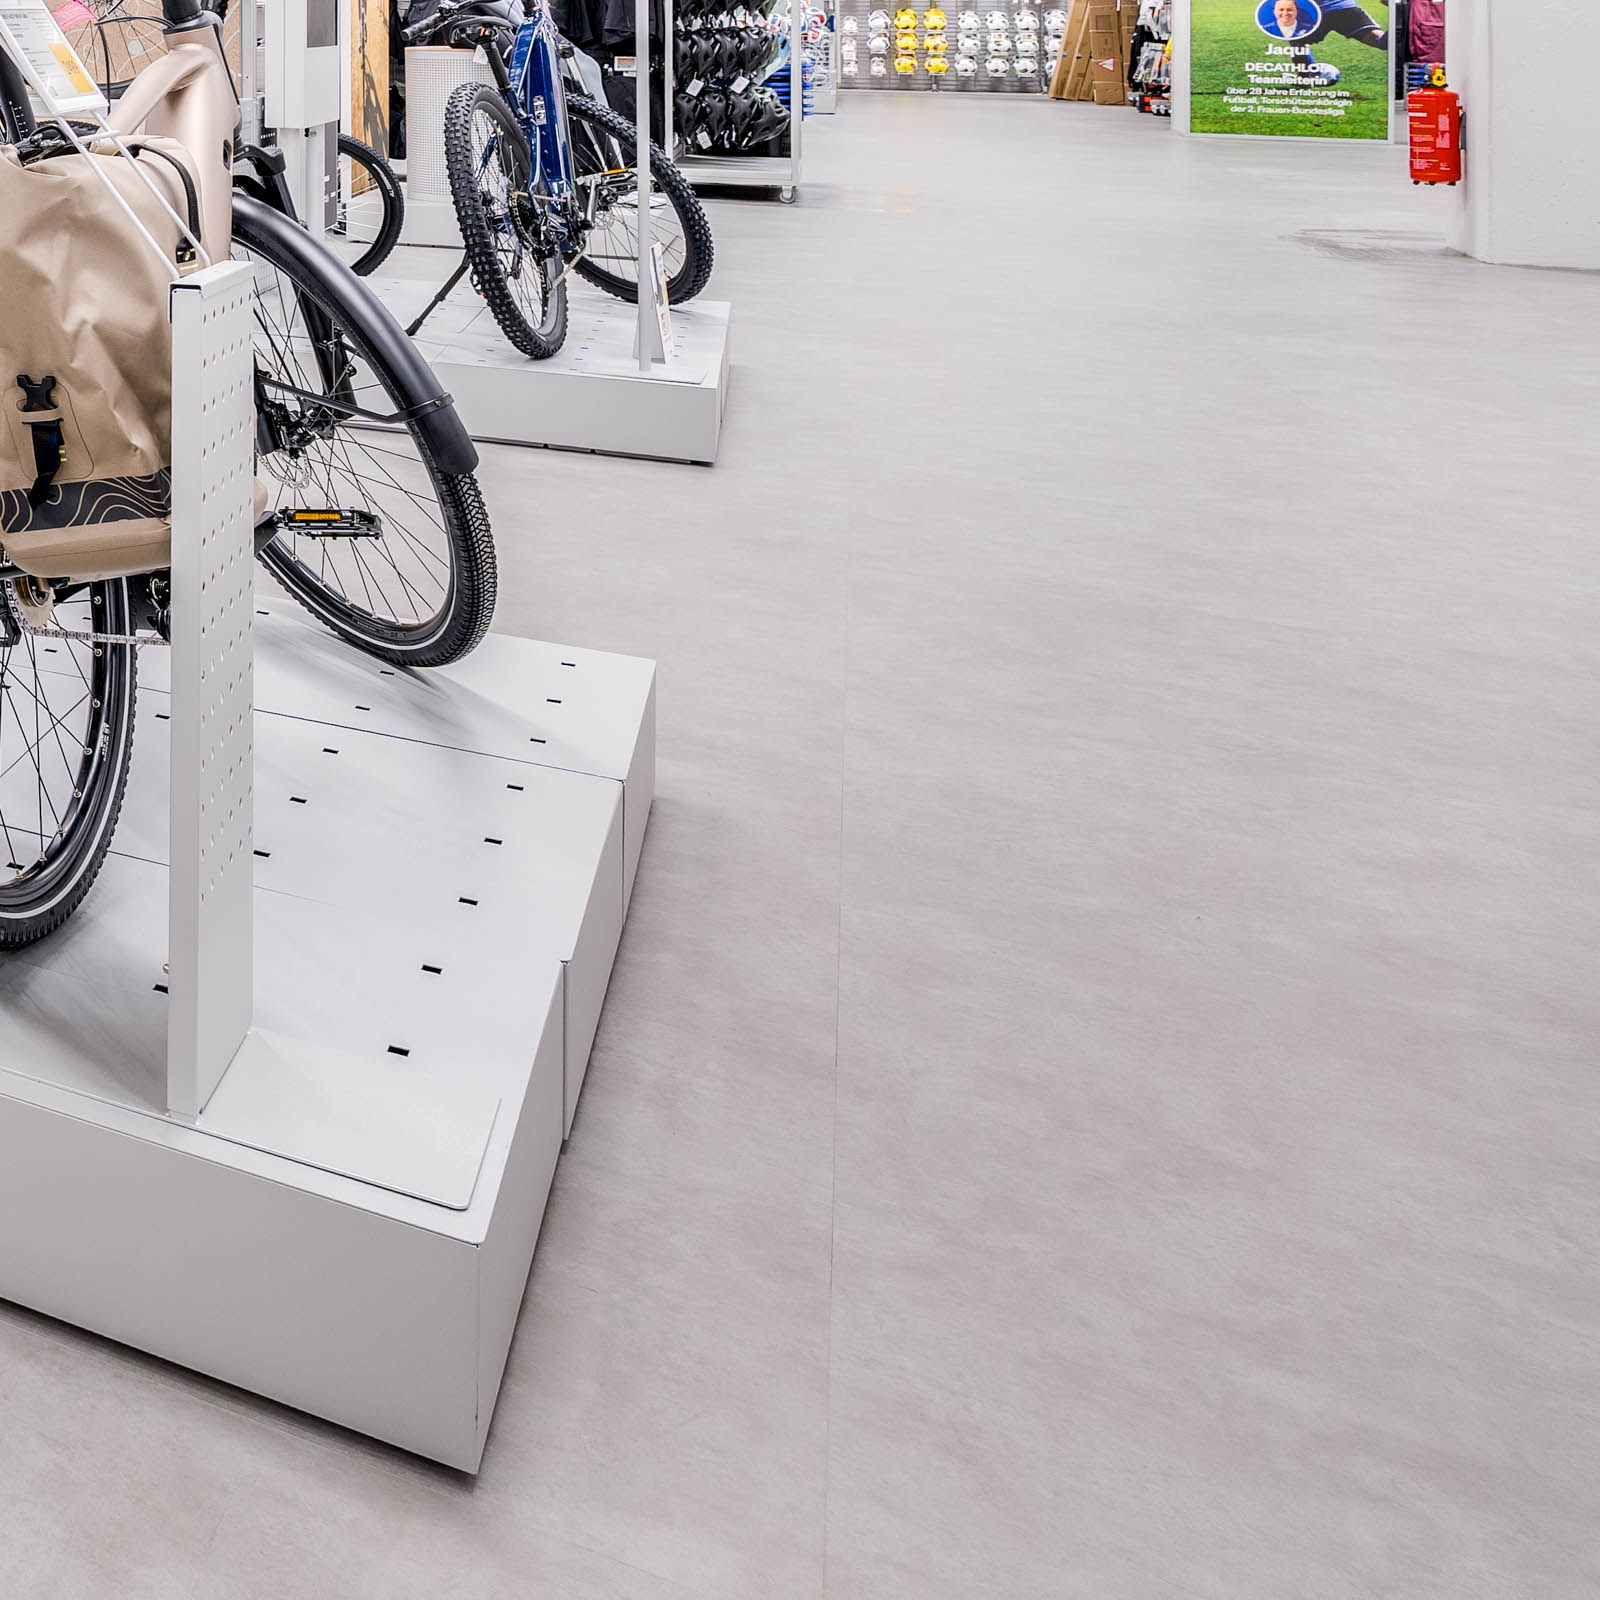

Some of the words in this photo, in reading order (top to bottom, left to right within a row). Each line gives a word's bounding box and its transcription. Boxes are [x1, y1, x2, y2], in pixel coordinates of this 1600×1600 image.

[1265, 43, 1311, 57] Jaqui
[1245, 62, 1320, 72] DECATHLO
[1248, 74, 1328, 87] Teamleiterin
[1263, 88, 1288, 96] Jahre
